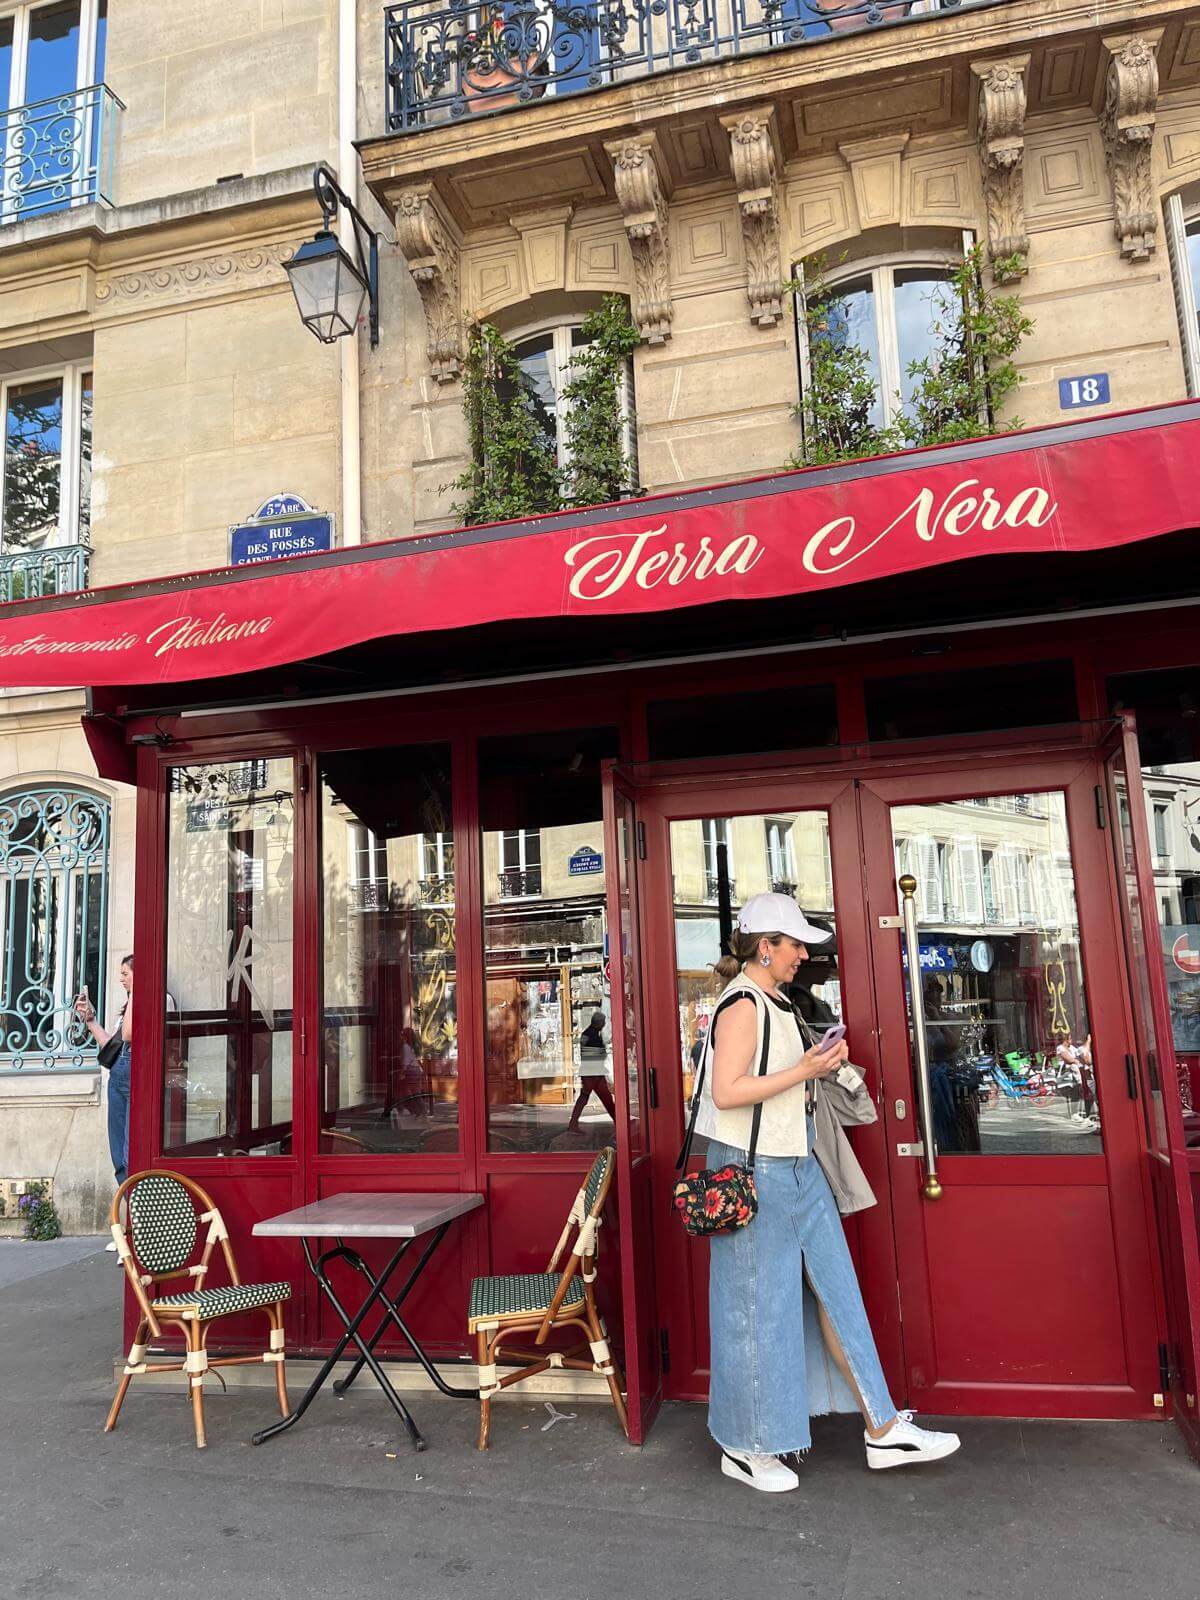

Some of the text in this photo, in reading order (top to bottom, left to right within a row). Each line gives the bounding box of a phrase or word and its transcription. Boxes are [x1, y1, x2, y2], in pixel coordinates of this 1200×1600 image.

[1070, 378, 1099, 404] 18
[247, 543, 268, 555] DES
[272, 536, 315, 552] FOSSÉS
[269, 526, 293, 539] RUE
[563, 477, 1058, 601] Terra Nera
[0, 611, 273, 659] astronomia Italiana
